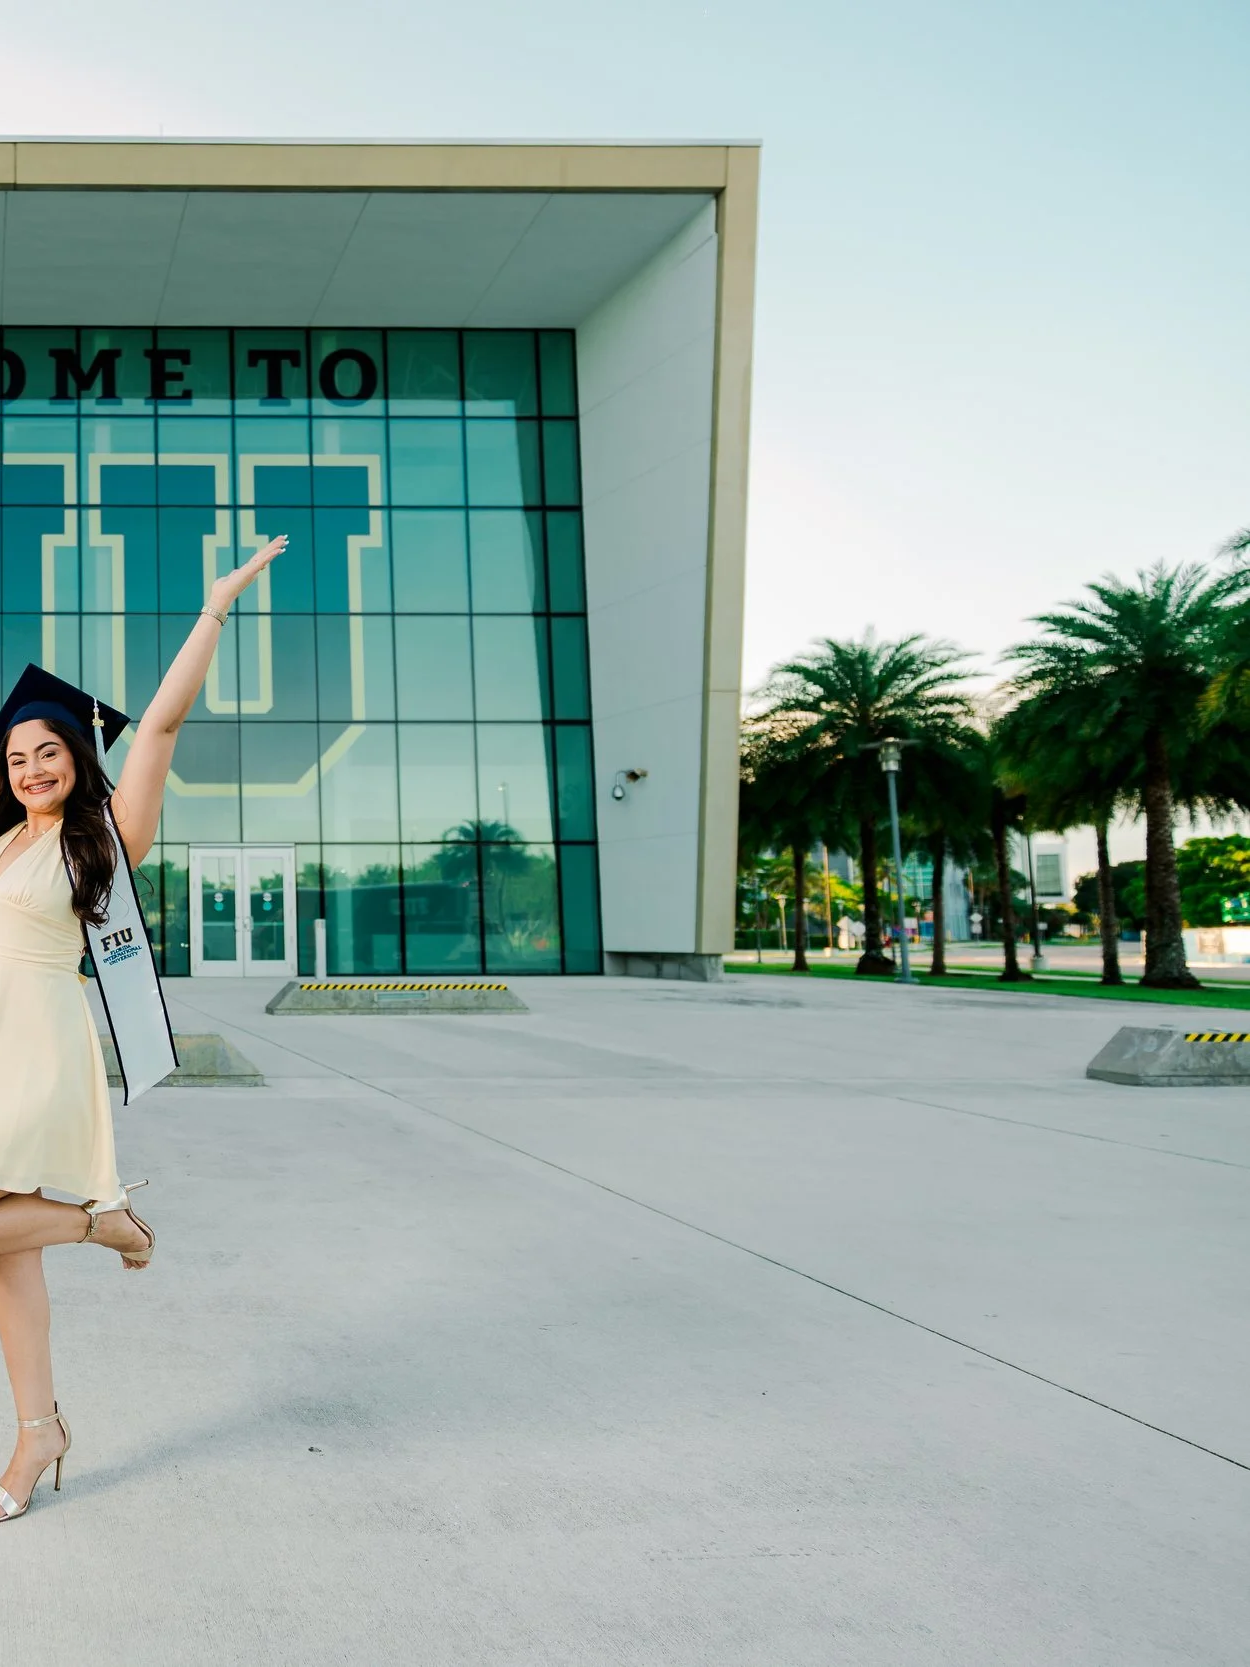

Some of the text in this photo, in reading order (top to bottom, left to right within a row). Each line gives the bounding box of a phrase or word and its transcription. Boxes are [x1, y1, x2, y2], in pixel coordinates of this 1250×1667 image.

[247, 348, 378, 407] TO
[101, 928, 133, 951] FIU
[103, 945, 142, 963] INTERNATIONAL
[109, 951, 138, 965] UNIVERSITY
[110, 944, 131, 955] FLORIDA
